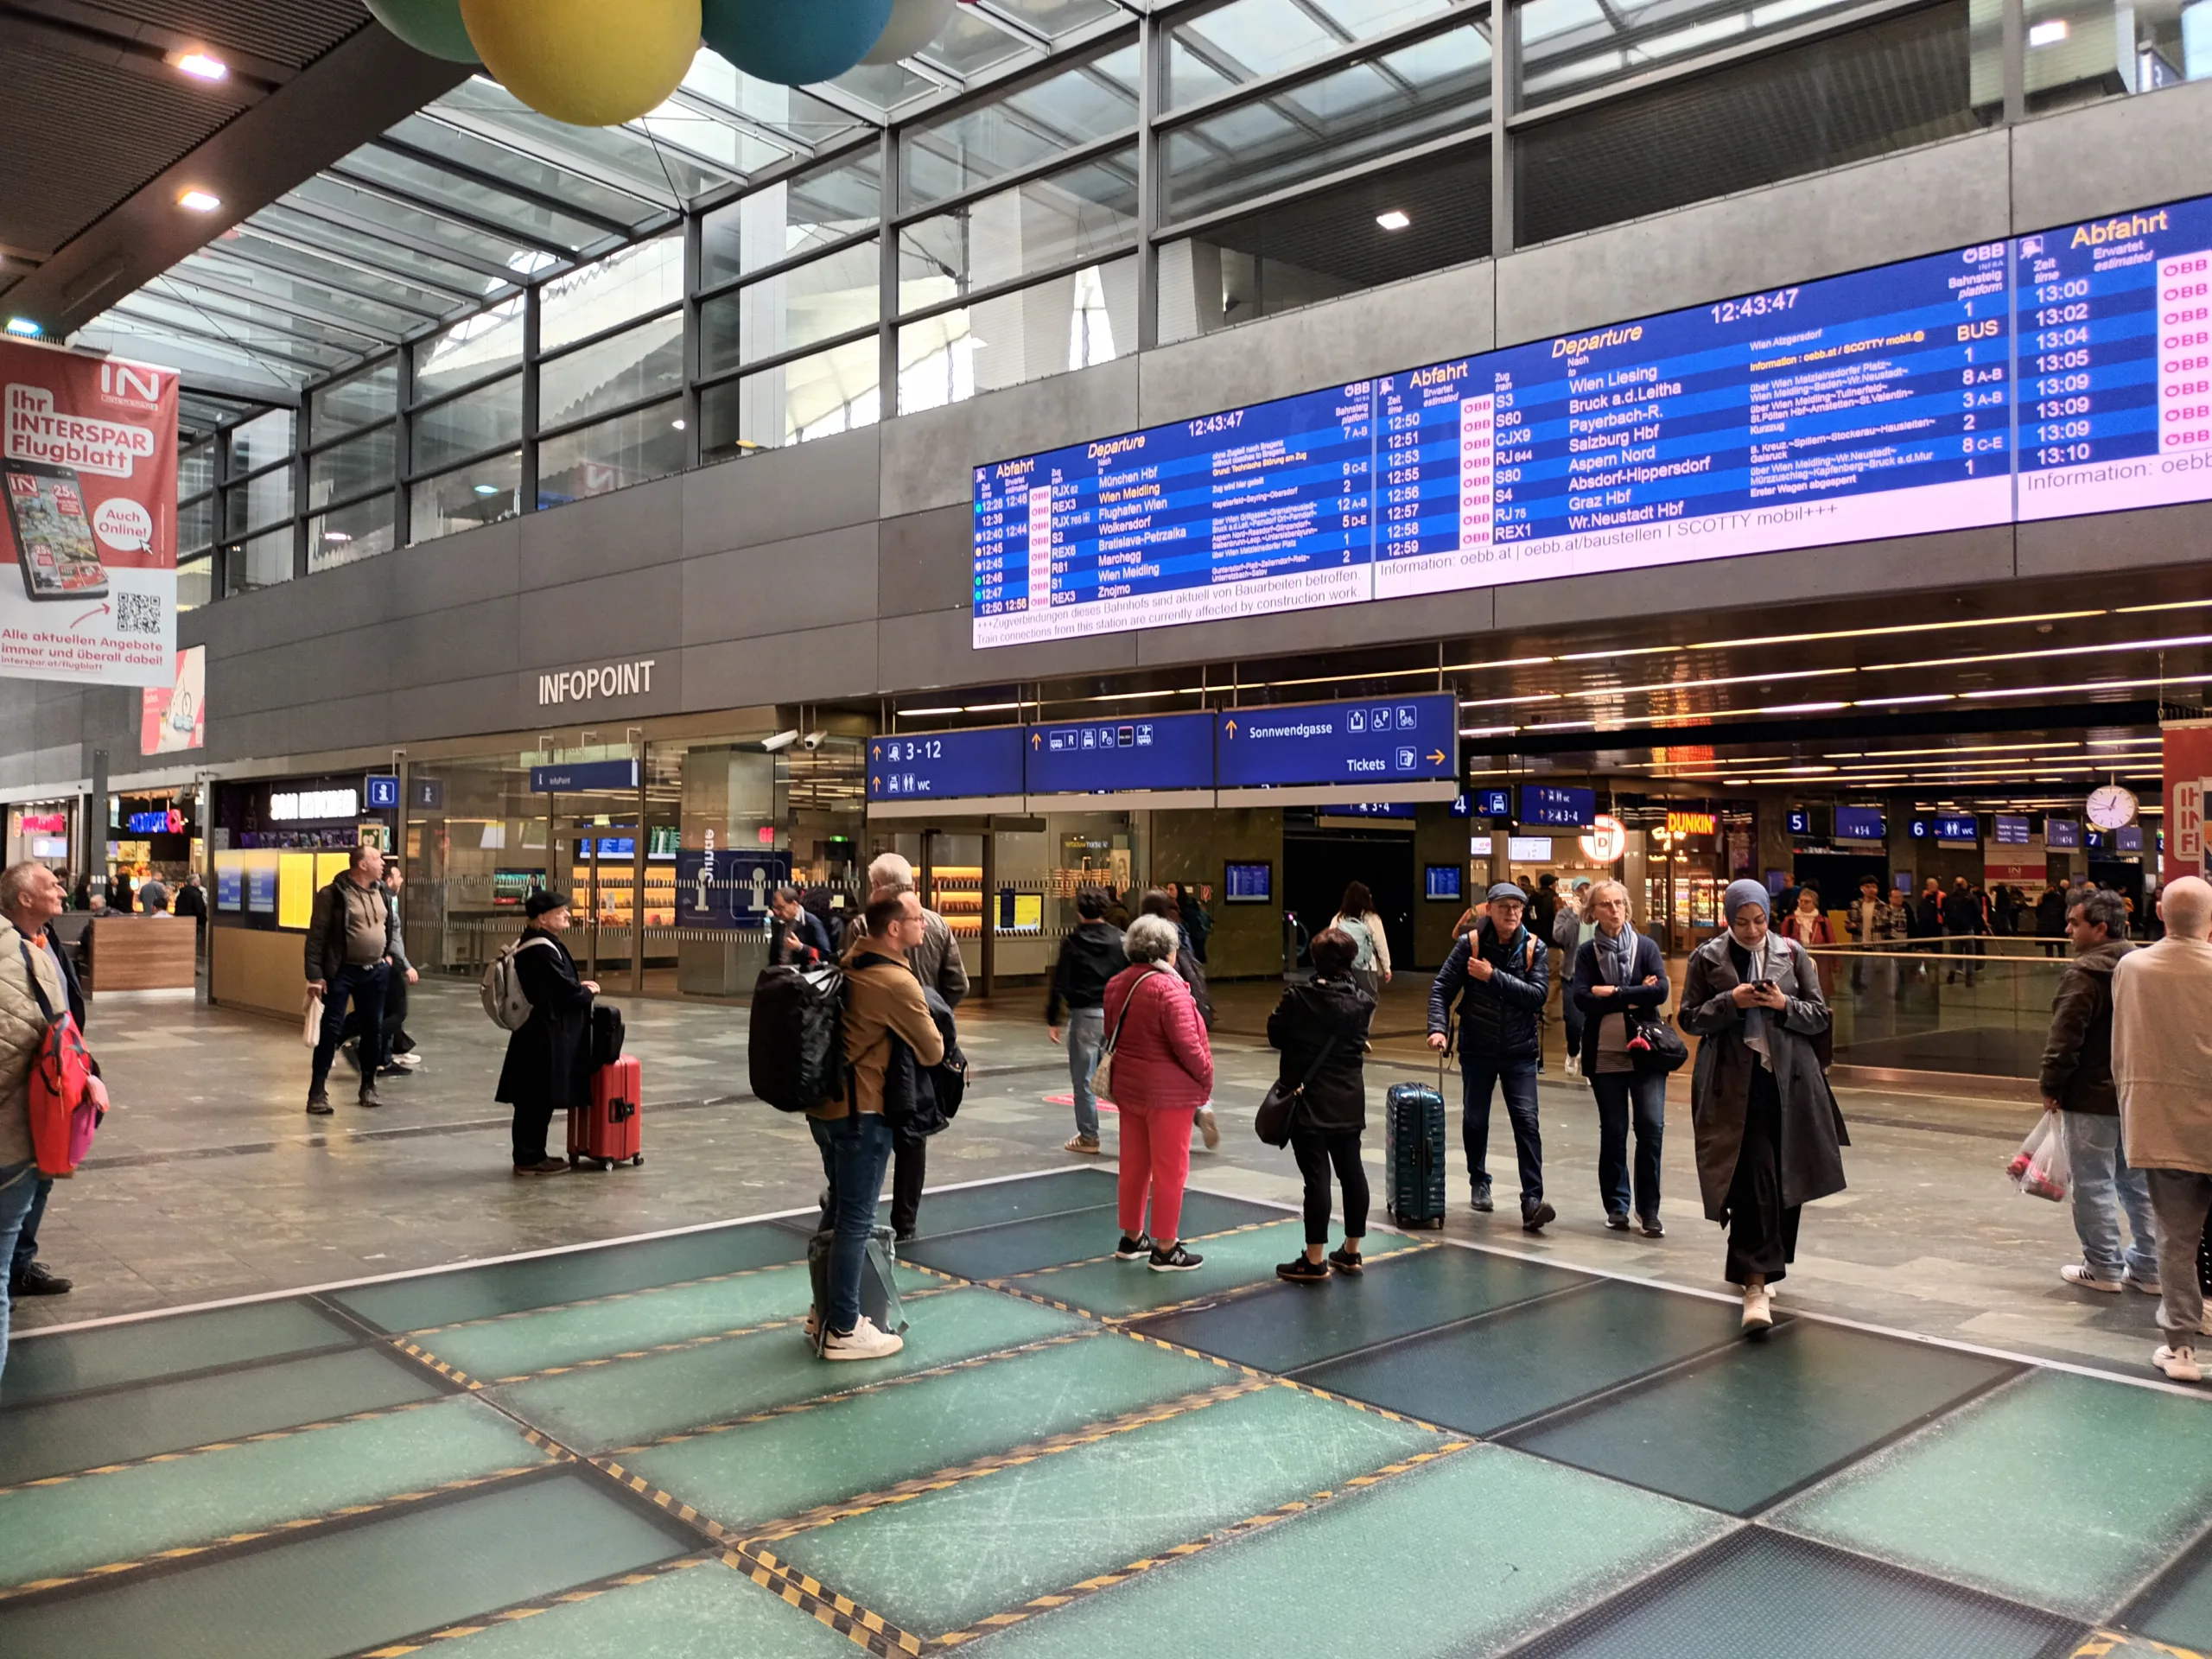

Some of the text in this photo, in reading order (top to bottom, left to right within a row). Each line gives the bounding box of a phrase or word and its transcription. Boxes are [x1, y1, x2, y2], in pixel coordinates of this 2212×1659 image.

[2070, 211, 2168, 249] Abfahrt
[2033, 239, 2144, 271] Zeit Erwartet
[2035, 251, 2154, 283] time estimated
[2036, 279, 2088, 303] 13:00
[2036, 303, 2089, 327] 13:02
[1388, 270, 2002, 405] Zeit Erwartet Zug Nach Bahnsteig
[1410, 288, 1799, 389] Abfahrt Departure 12:43:47
[1424, 392, 1459, 407] estimated
[1958, 282, 2003, 301] platform
[1750, 340, 1771, 351] Wien
[2036, 327, 2089, 350] 13:04
[1388, 302, 1973, 430] 12:50 S3 Wien Liesing 1
[1751, 337, 1884, 372] Information SCOTTY
[2036, 349, 2089, 372] 13:05
[101, 364, 159, 402] IN
[1388, 320, 1998, 448] 12:51 S60 Bruck BUS
[2036, 373, 2089, 396] 13:09
[13, 391, 48, 412] Ihr
[1388, 346, 1973, 467] 12:53 CJX9 Payerbach-R. 1
[2037, 397, 2090, 419] 13:09
[13, 412, 147, 450] INTERSPAR
[1388, 368, 2002, 486] 12:55 RJ 644 Salzburg Hbf 8 A-B
[1751, 422, 1785, 435] Kurzzug
[2037, 421, 2090, 442] 13:09
[12, 435, 127, 468] Flugblatt
[996, 410, 1243, 479] Abfahrt Departure 12:43:47
[1388, 392, 1974, 503] 12:56 S80 Aspern Nord 3
[2037, 443, 2090, 465] 13:10
[1052, 427, 1351, 498] RJX München Hbf 7
[1388, 415, 1975, 521] 12:57 S4 Absdorf-Hippersdorf 2
[2028, 462, 2152, 491] Information:
[10, 478, 37, 493] IN
[1099, 484, 1160, 504] Wien Meidling
[1387, 437, 1974, 539] 12:58 RJ Graz Hbf 8
[106, 509, 140, 522] Auch
[1052, 480, 1351, 543] S2 Wolkersdorf 2
[1052, 499, 1167, 529] RJX Flughafen Wien
[1387, 460, 1973, 556] 12:59 REX1 Wr.Neustadt Hbf 1
[99, 523, 147, 537] Online!
[1098, 499, 1350, 551] Bratislava-Petrzalka 12
[1098, 515, 1349, 567] Marchegg 5
[1381, 513, 1751, 575] Information: oebb.at oebb.at/baustellen SCOTTY
[1052, 533, 1349, 588] S1 Wien Meidling 1
[1098, 550, 1350, 598] Znojmo 2
[1104, 577, 1302, 612] Bahnhofs sind aktuell von Bauarbeiten
[978, 593, 1325, 645] Train connections from this station are currently affected by construction
[2, 628, 162, 652] Alle aktuellen Angebote
[2, 644, 162, 665] immer und überall dabei!
[2, 657, 103, 671] interspar.at/flugblatt
[538, 660, 655, 705] INFOPOINT
[1249, 722, 1332, 740] Sonnwendgasse
[1346, 759, 1386, 772] Tickets
[1454, 796, 1466, 813] 4
[1668, 812, 1715, 834] DUNKIN'
[1792, 815, 1802, 830] 5
[1914, 823, 1923, 836] 6
[2089, 834, 2096, 845] 7
